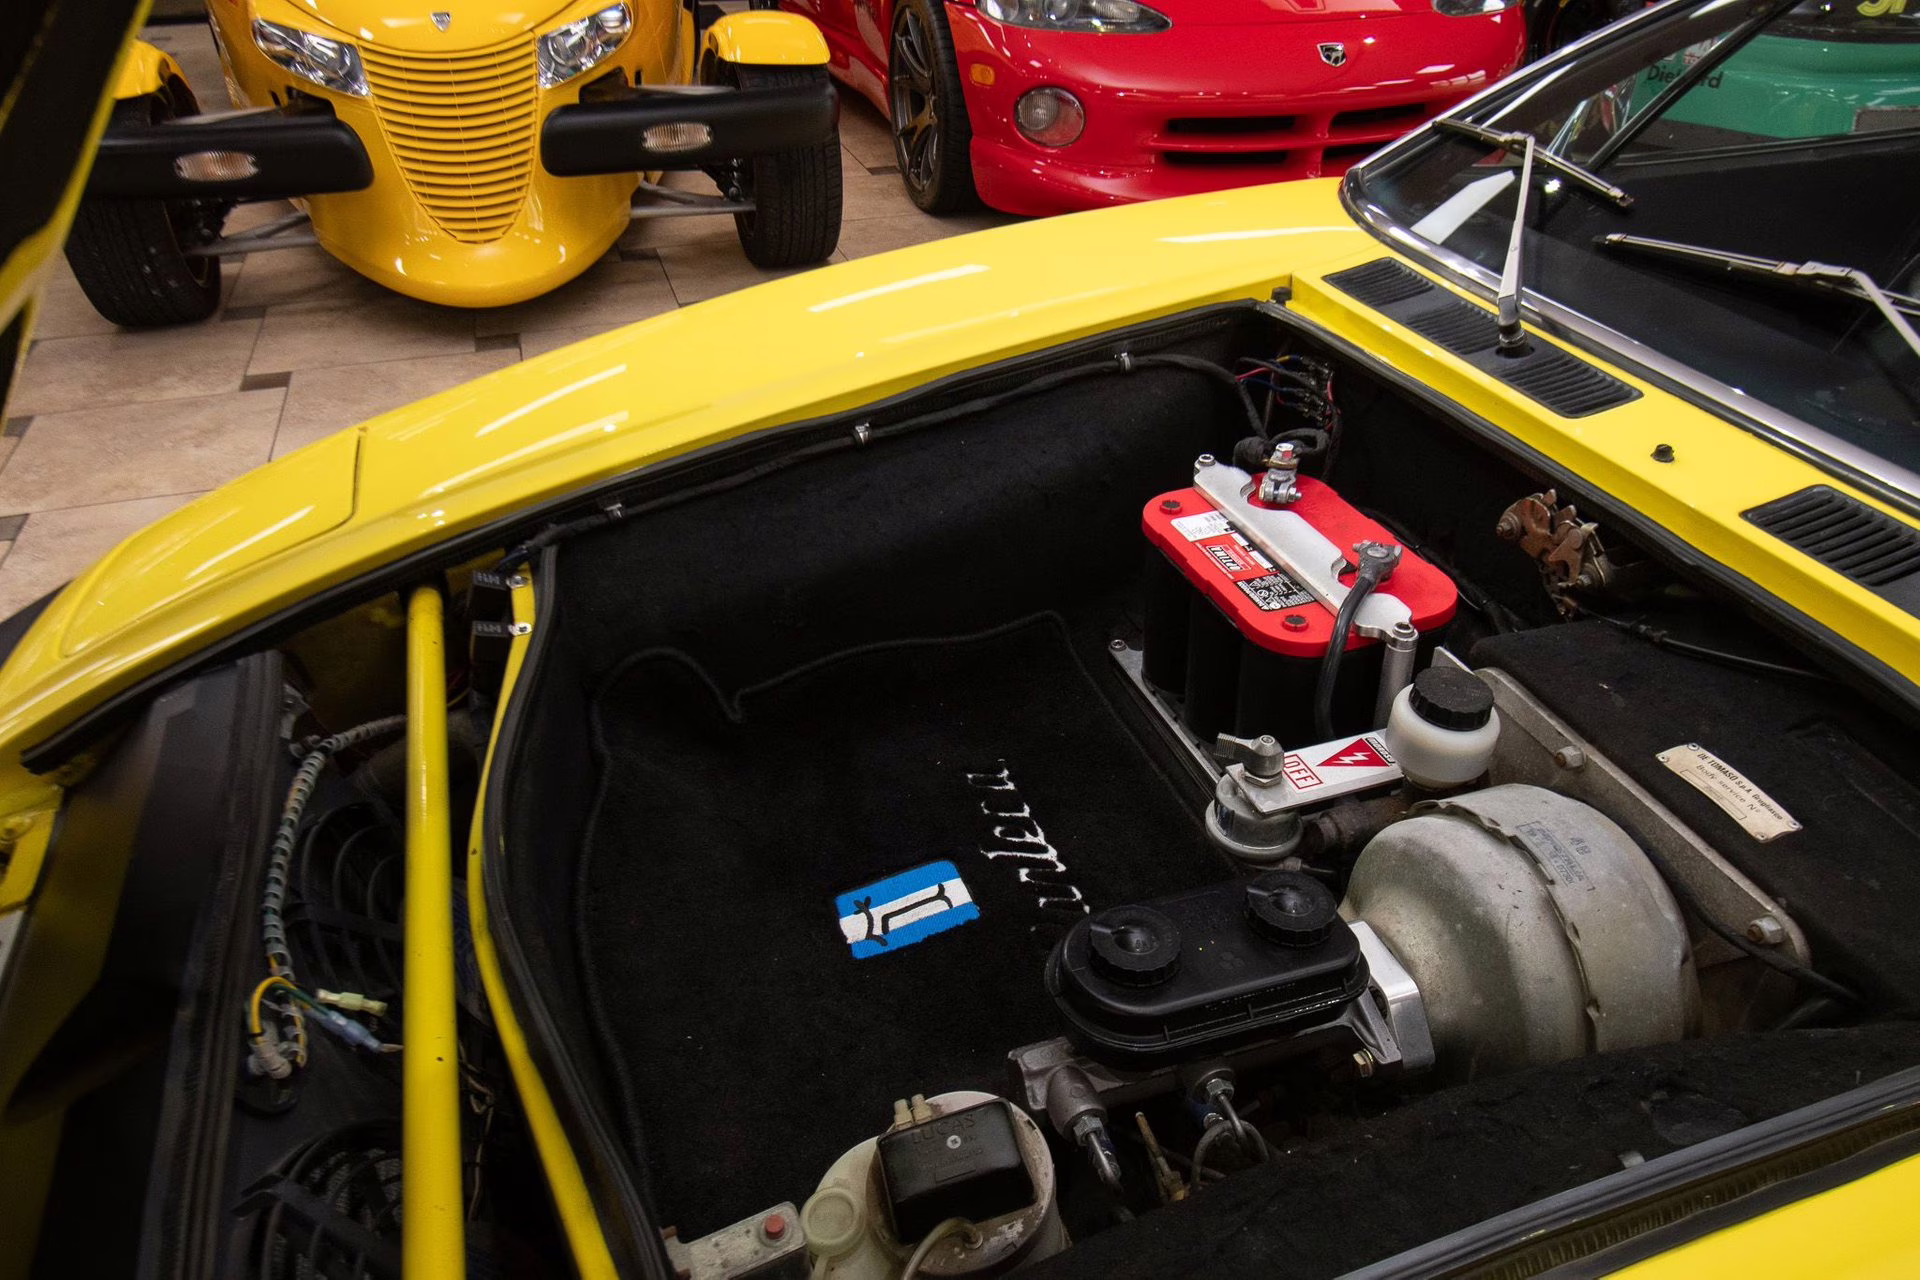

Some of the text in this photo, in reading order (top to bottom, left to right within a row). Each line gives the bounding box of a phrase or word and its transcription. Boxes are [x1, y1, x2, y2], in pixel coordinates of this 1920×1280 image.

[1646, 64, 1724, 89] Dierd
[1208, 545, 1243, 572] OPTIMA
[1284, 760, 1315, 783] OFF
[1697, 752, 1708, 761] DE
[1707, 760, 1738, 781] TOMASO
[1696, 764, 1717, 780] Body
[1719, 780, 1746, 802] service
[914, 1114, 975, 1145] LUCAS
